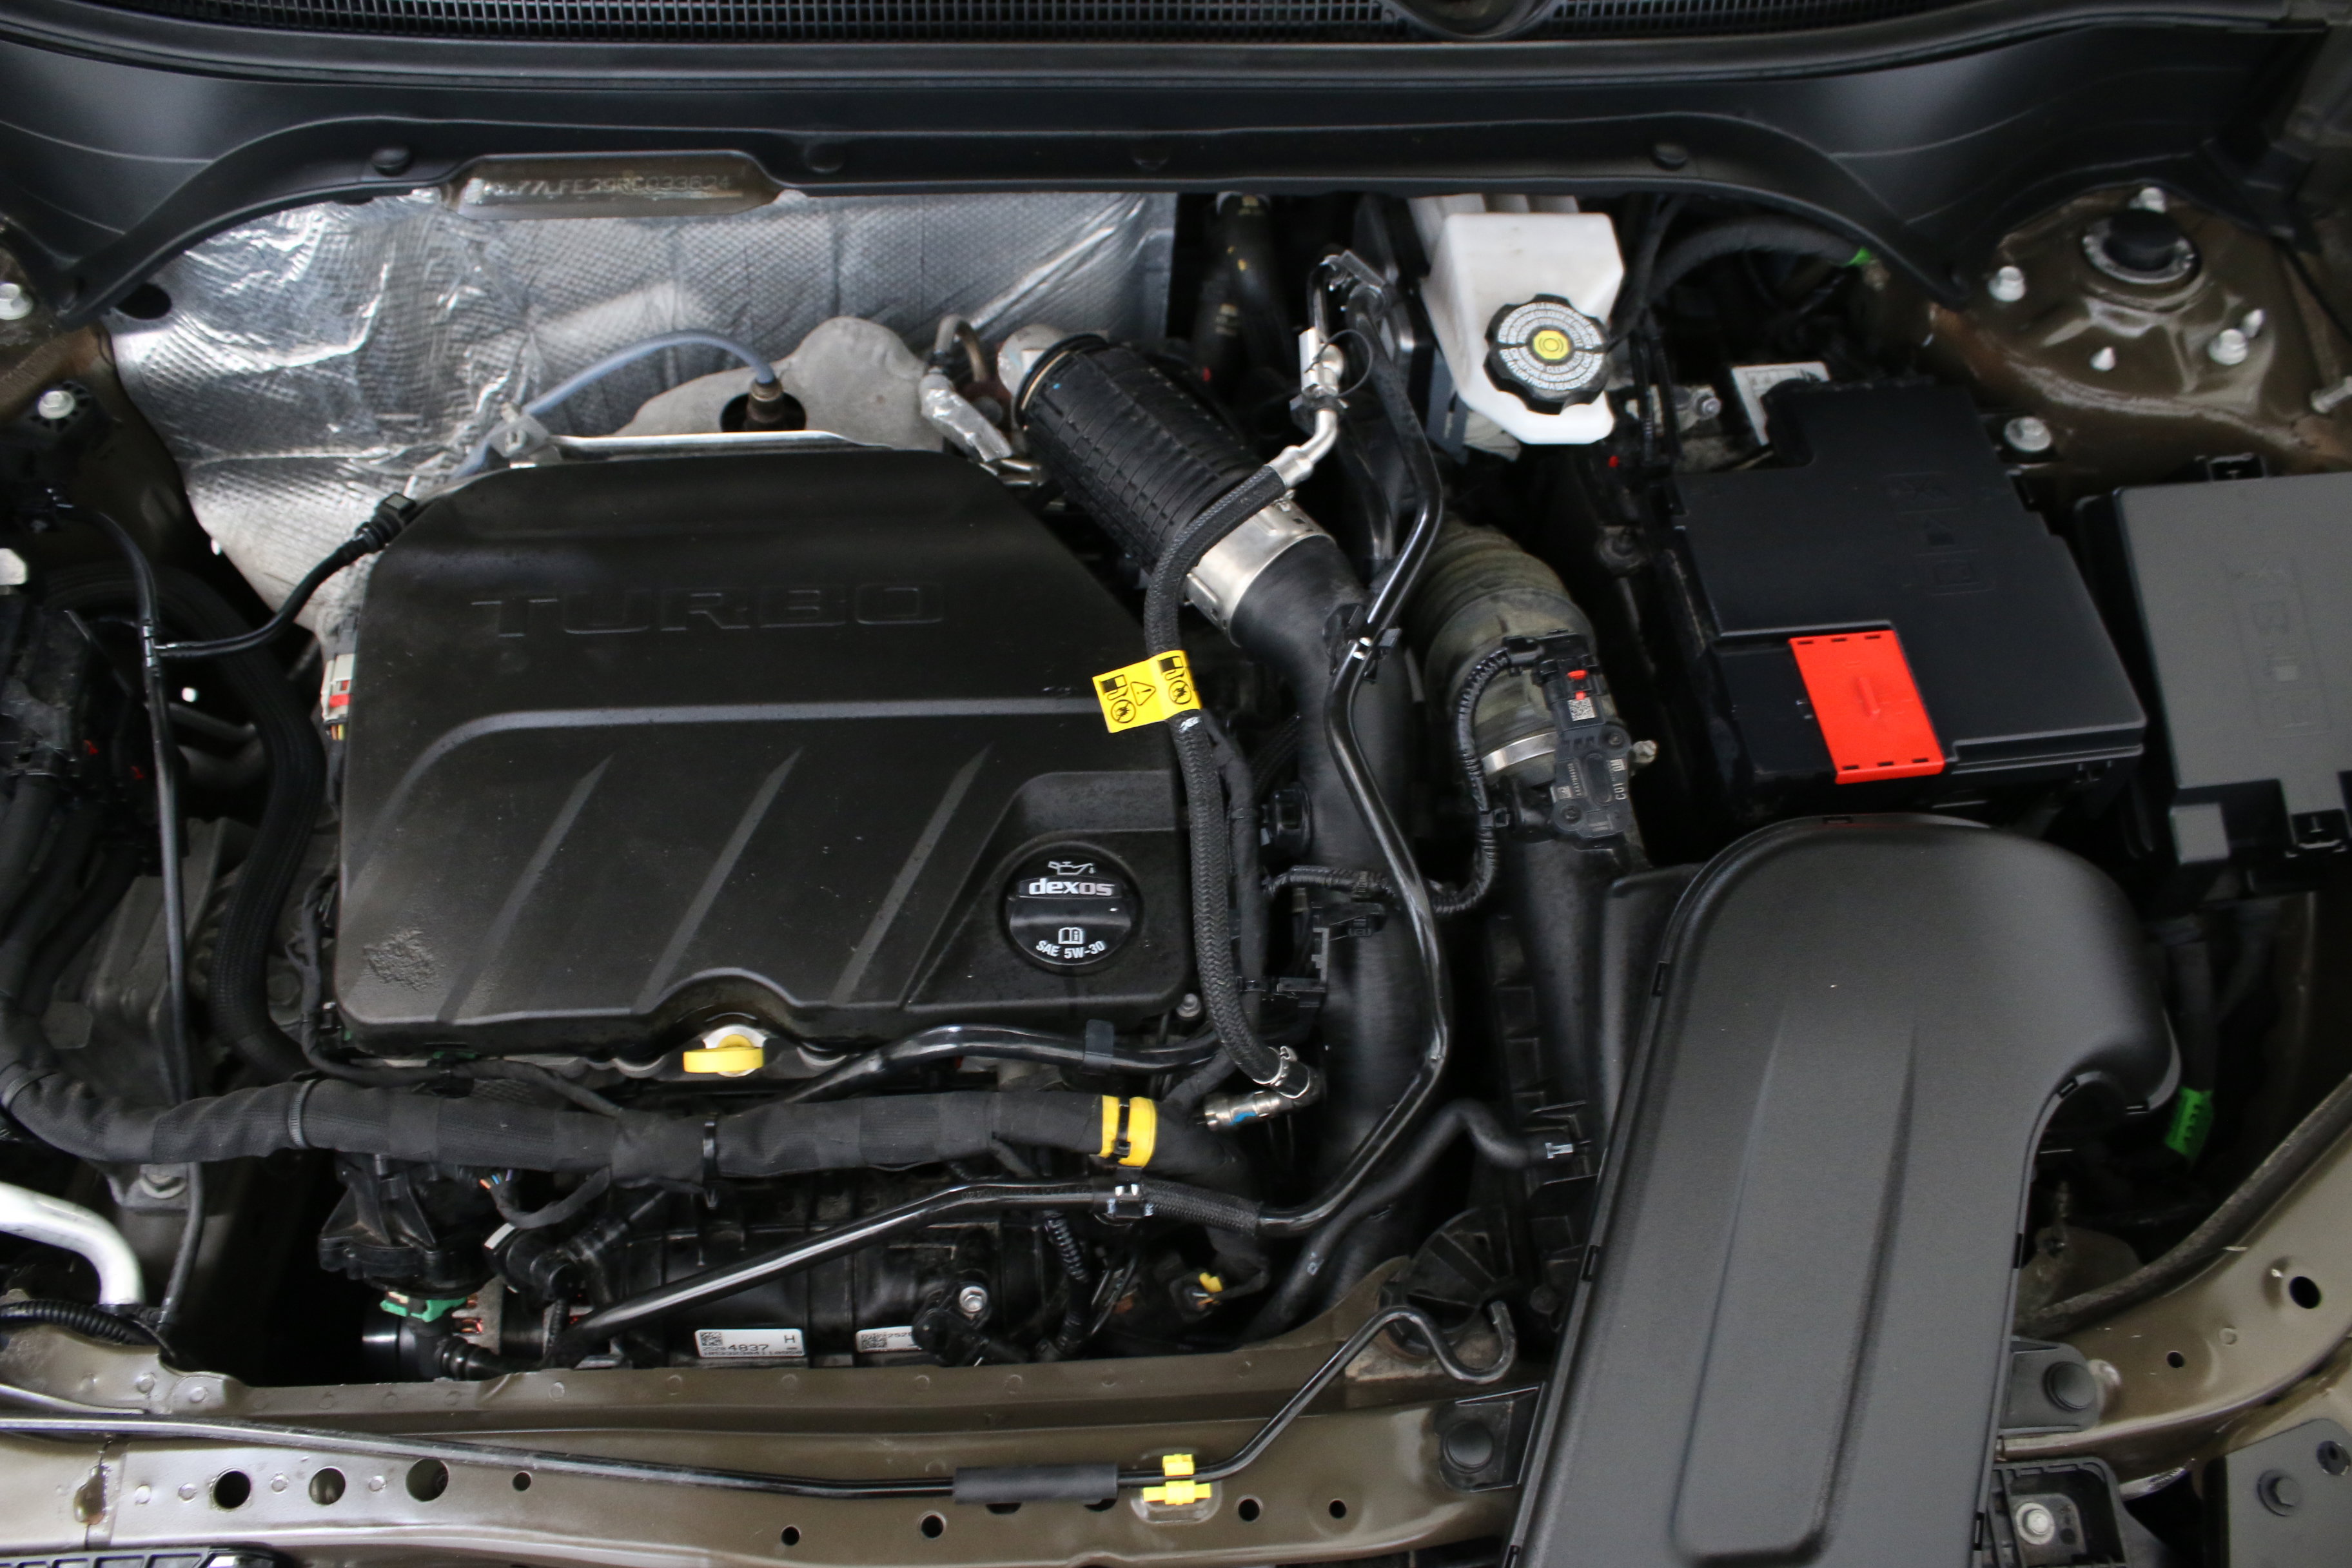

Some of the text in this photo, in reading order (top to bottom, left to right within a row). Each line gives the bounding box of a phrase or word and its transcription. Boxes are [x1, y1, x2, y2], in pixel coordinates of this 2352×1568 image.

[470, 584, 943, 638] TURBO
[1028, 878, 1115, 897] dexos
[1035, 940, 1106, 959] SAE 5W-30
